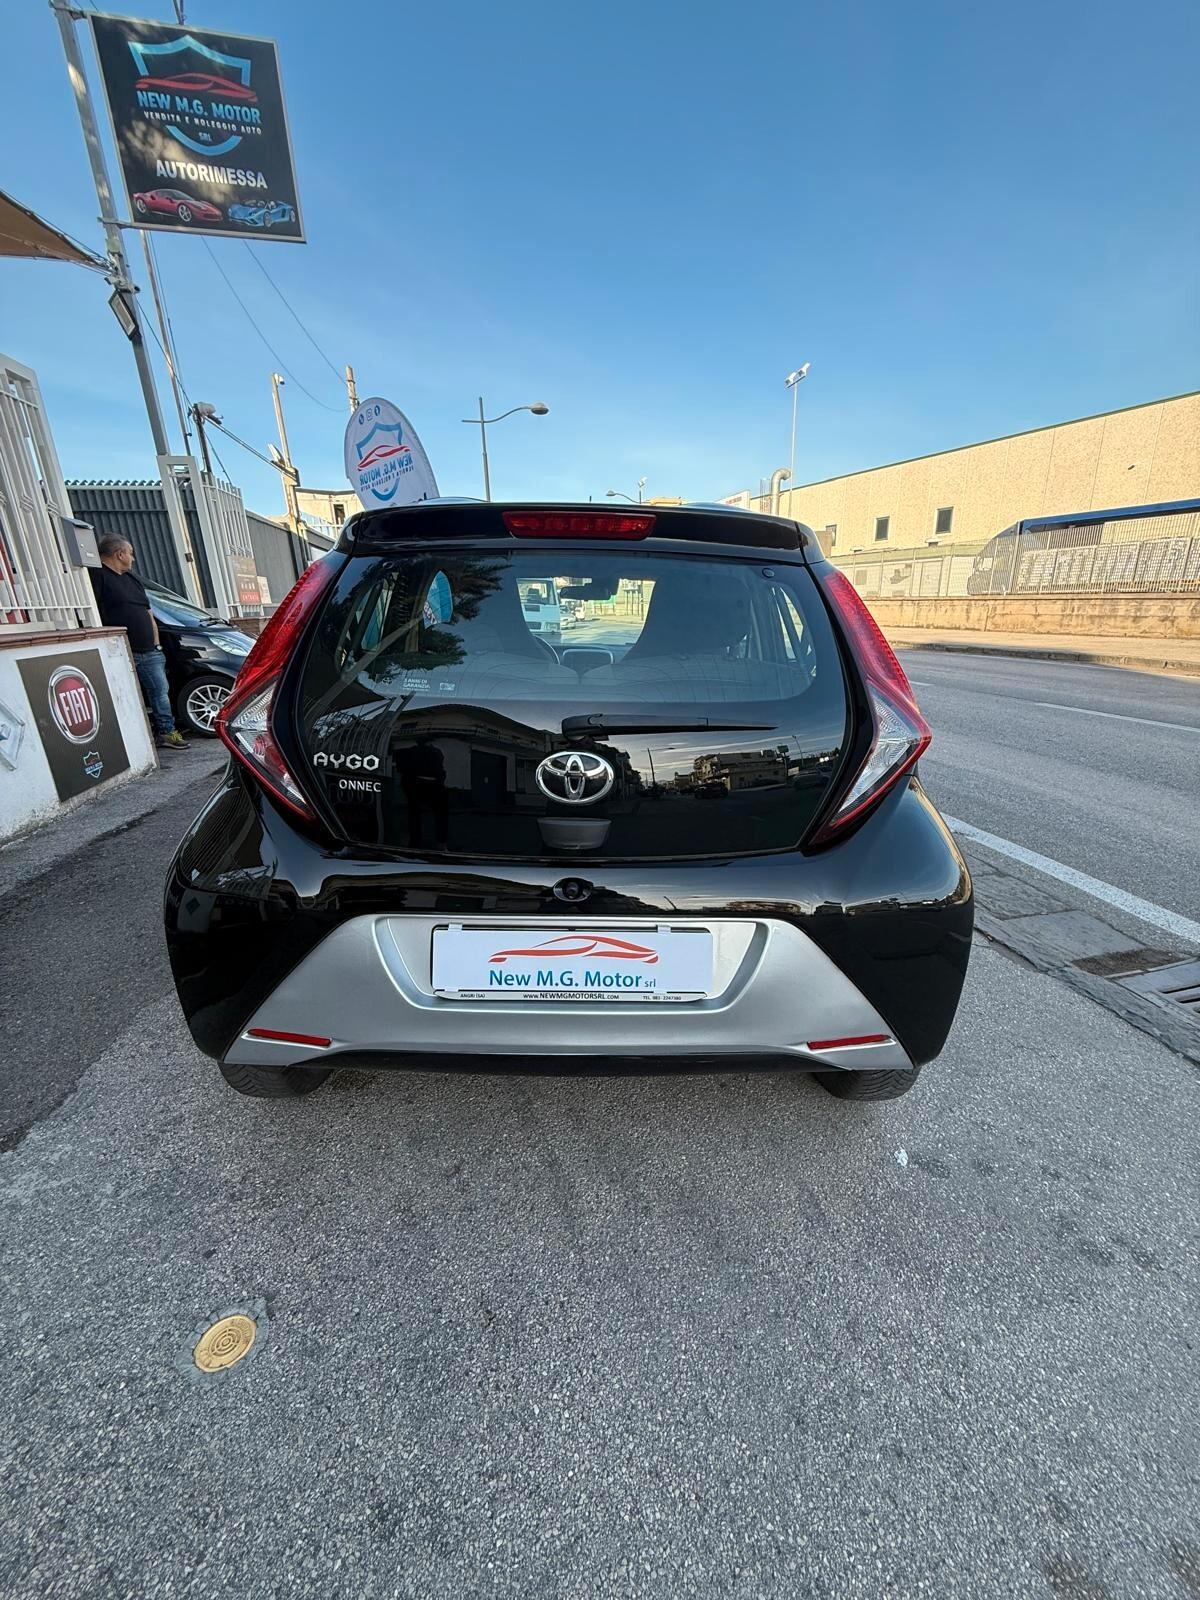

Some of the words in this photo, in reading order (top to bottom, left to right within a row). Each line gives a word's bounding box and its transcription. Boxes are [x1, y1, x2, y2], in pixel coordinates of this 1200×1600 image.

[137, 91, 171, 109] NEW
[175, 96, 208, 116] M.G.
[211, 102, 261, 123] MOTOR
[143, 110, 181, 123] VENDITA
[185, 116, 190, 124] E
[194, 117, 237, 132] NOLEGGIO
[241, 125, 262, 135] AUTO
[156, 159, 268, 189] AUTORIMESSA
[58, 687, 91, 727] FIAT
[313, 751, 380, 771] AYGO
[339, 779, 381, 793] ONNEC
[489, 970, 532, 987] New
[536, 970, 579, 987] M.G.
[584, 970, 642, 987] Motor
[644, 978, 656, 988] srl
